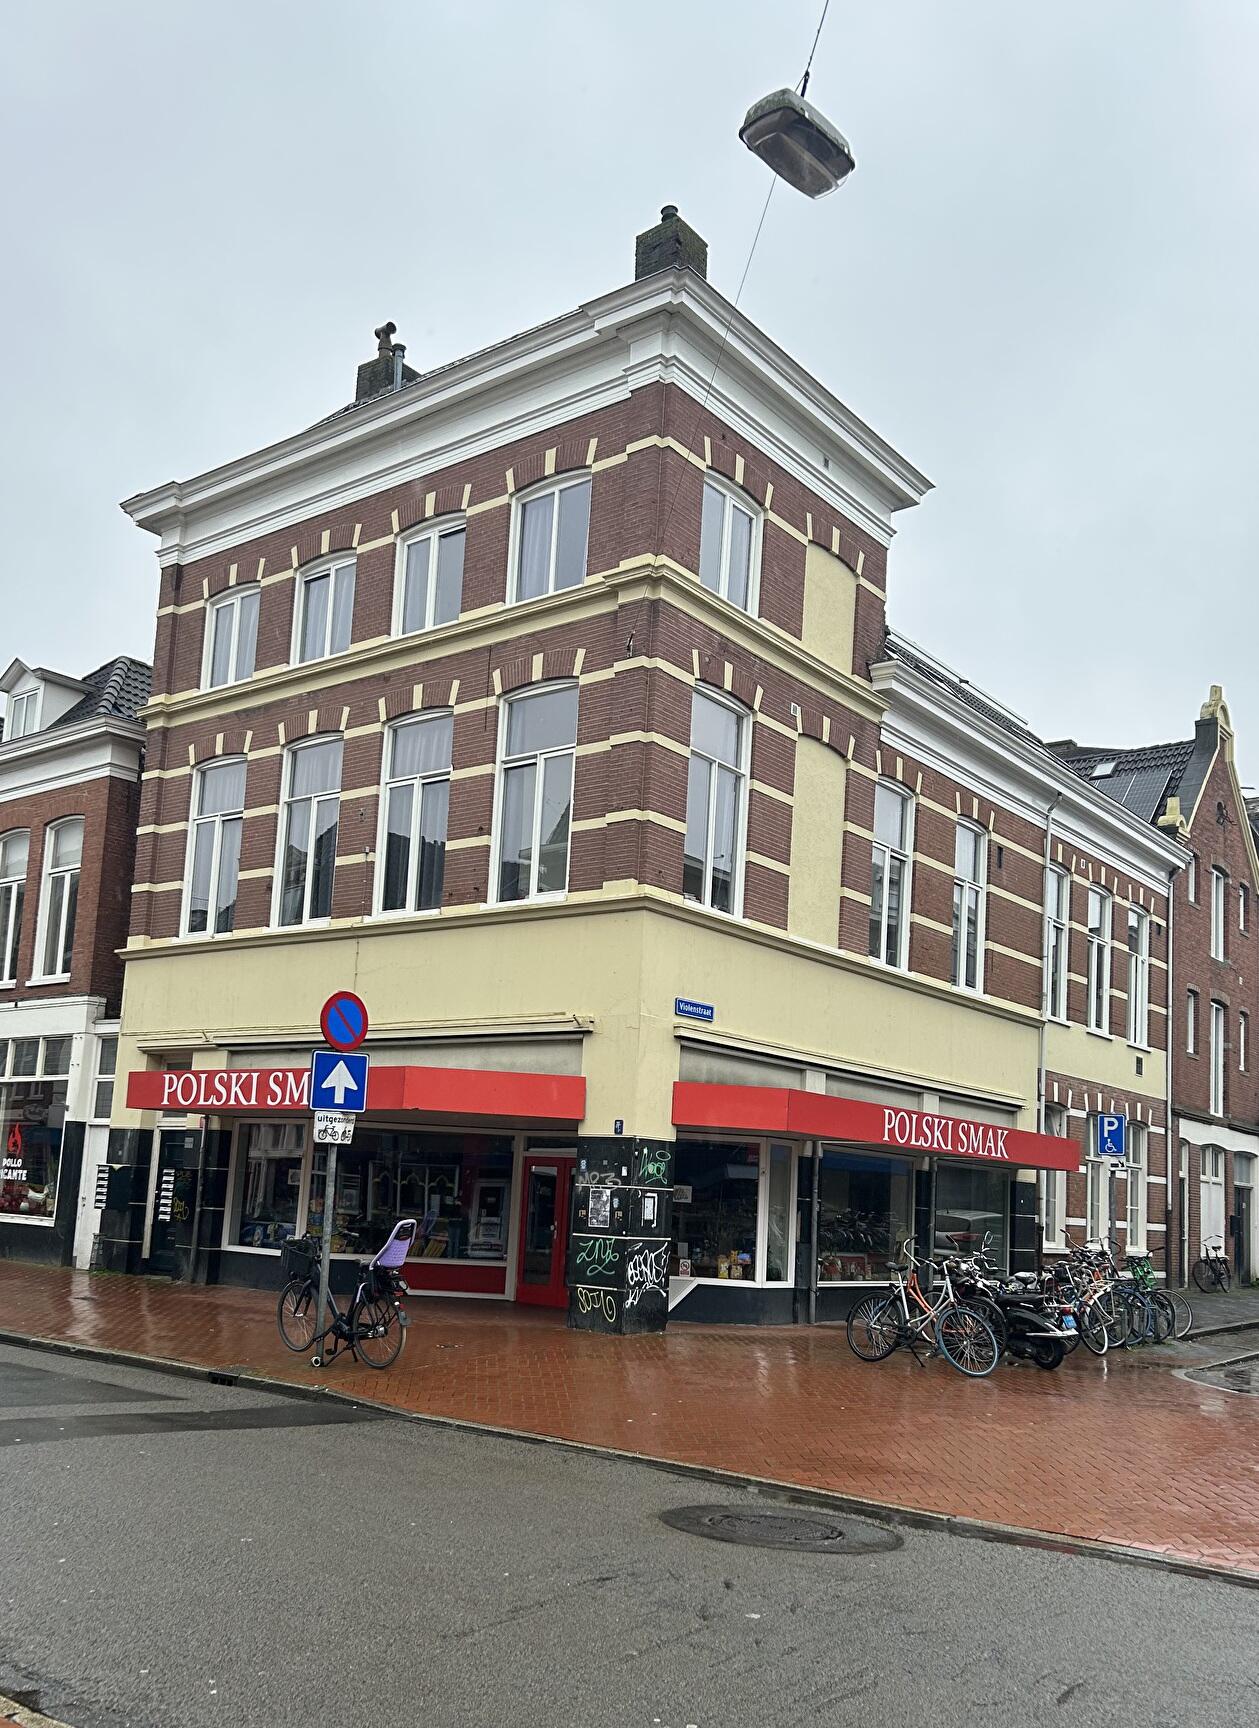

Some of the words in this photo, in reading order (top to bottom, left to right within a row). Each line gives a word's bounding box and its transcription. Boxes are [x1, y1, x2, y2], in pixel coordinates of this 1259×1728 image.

[679, 1002, 712, 1017] Violenstraat
[161, 1072, 260, 1106] POLSKI
[267, 1071, 311, 1106] SM
[883, 1109, 953, 1150] POLSKI
[958, 1122, 1009, 1159] SMAK
[1103, 1117, 1119, 1138] P
[2, 1157, 23, 1168] POLLO
[0, 1168, 28, 1181] ICANTE
